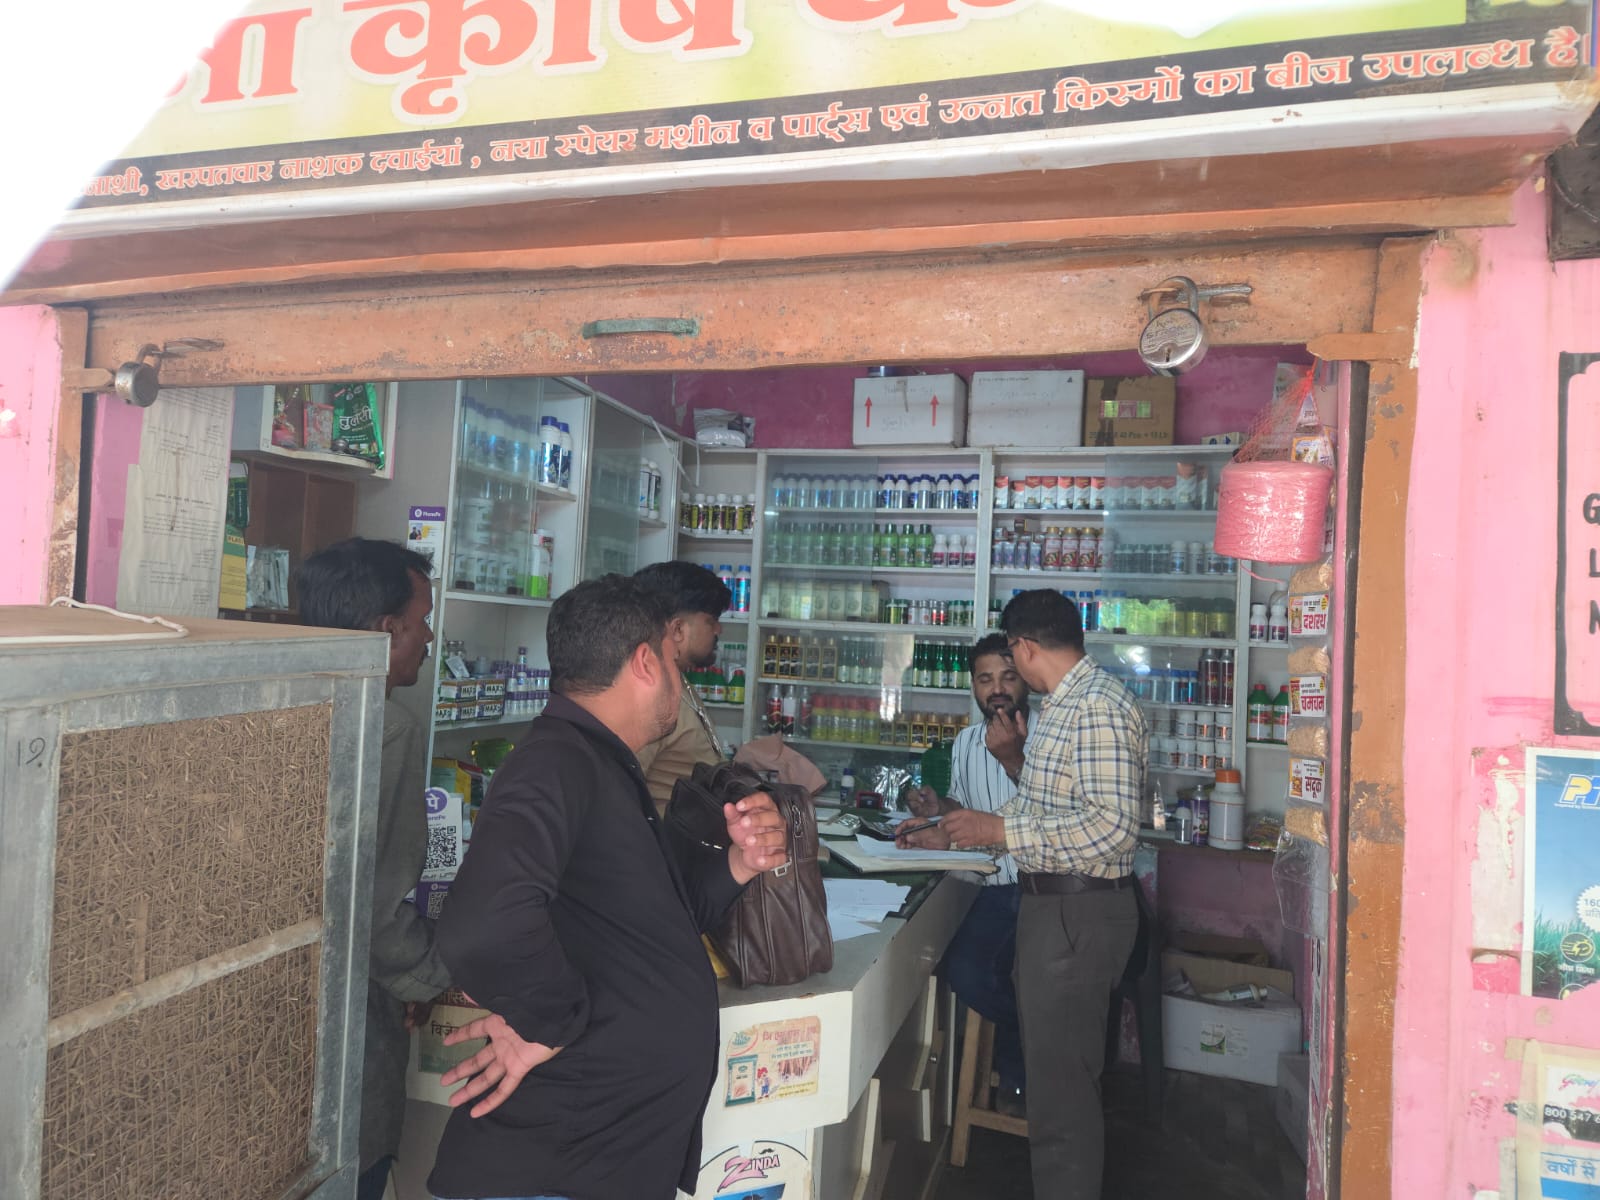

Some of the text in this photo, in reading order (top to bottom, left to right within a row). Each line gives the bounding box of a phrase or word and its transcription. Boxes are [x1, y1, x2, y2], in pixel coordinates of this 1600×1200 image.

[280, 152, 365, 180] नाशक
[490, 136, 549, 162] नया
[555, 125, 639, 156] स्पेयर
[644, 114, 741, 149] मशीन
[748, 117, 775, 141] व
[781, 101, 871, 142] पार्ट्स
[879, 93, 931, 131] एवं
[939, 89, 1045, 124] उन्नत
[1053, 66, 1184, 113] किस्मों
[1194, 65, 1256, 98] का
[1265, 51, 1354, 90] बीज
[1362, 39, 1535, 81] उपलब्ध
[1303, 614, 1327, 630] दशरथ
[1301, 695, 1325, 712] चमचम
[717, 1154, 780, 1193] ZINDA
[1546, 1159, 1597, 1179] वर्षों से
